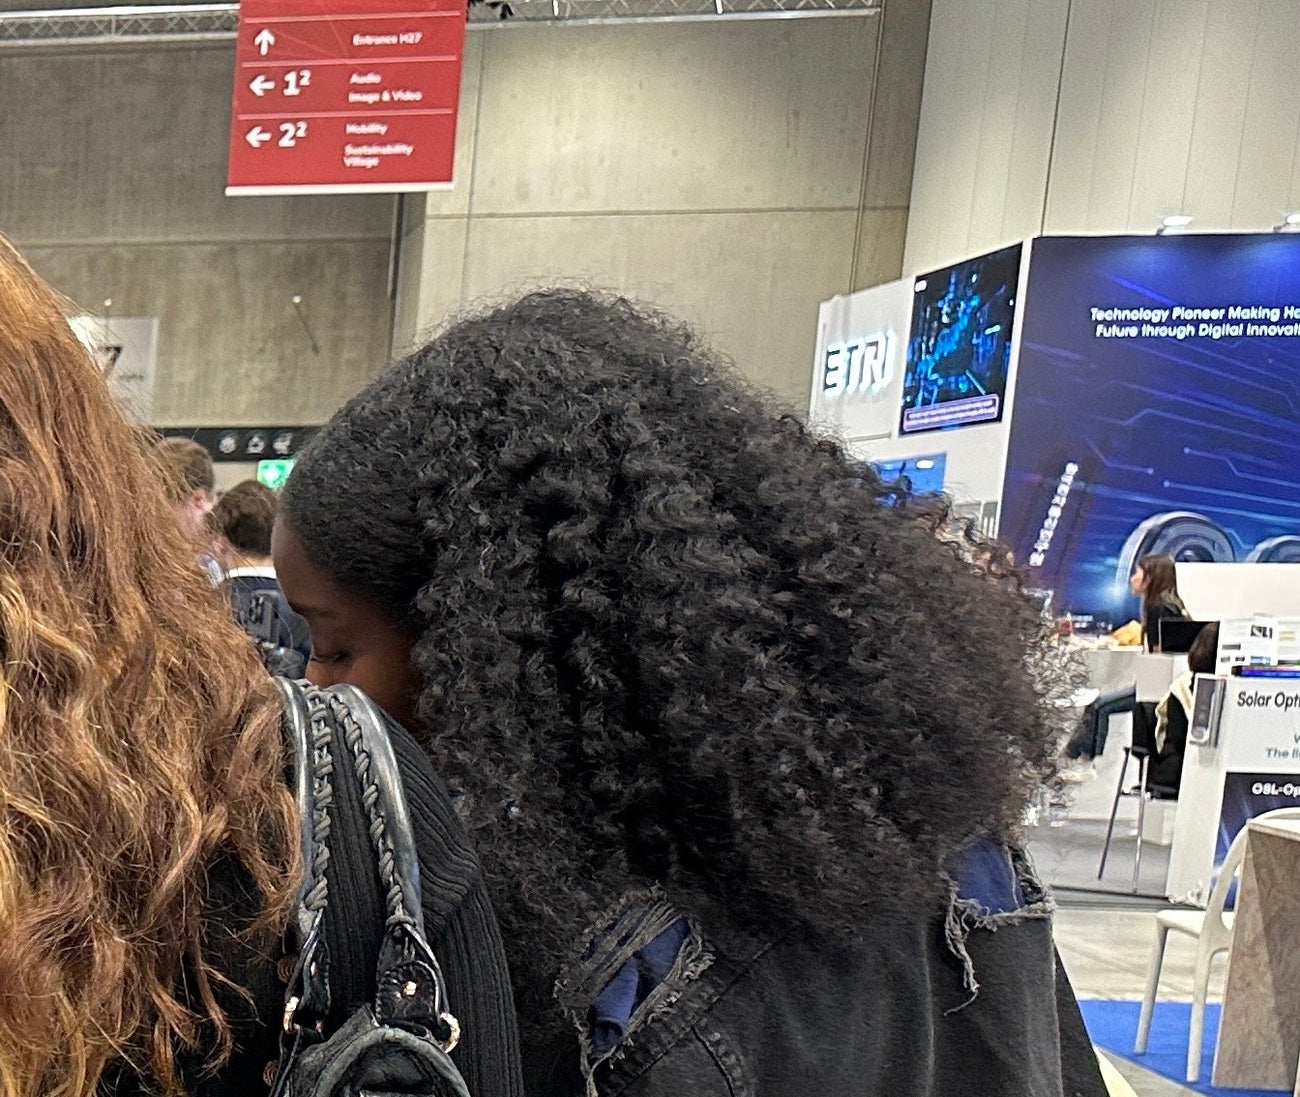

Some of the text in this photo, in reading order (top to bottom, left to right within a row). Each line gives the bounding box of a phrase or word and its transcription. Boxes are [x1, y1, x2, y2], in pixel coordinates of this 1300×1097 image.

[352, 33, 398, 46] Entrance
[349, 71, 382, 84] Audio
[348, 88, 423, 104] Image & Video
[345, 122, 389, 136] Mobility
[343, 156, 380, 169] Village
[1089, 306, 1170, 323] Technology
[1171, 306, 1226, 321] Pioneer
[1227, 304, 1281, 322] Making
[1095, 324, 1139, 338] Future
[1141, 323, 1196, 340] through
[1198, 322, 1244, 340] Digital
[1236, 690, 1272, 708] Solar
